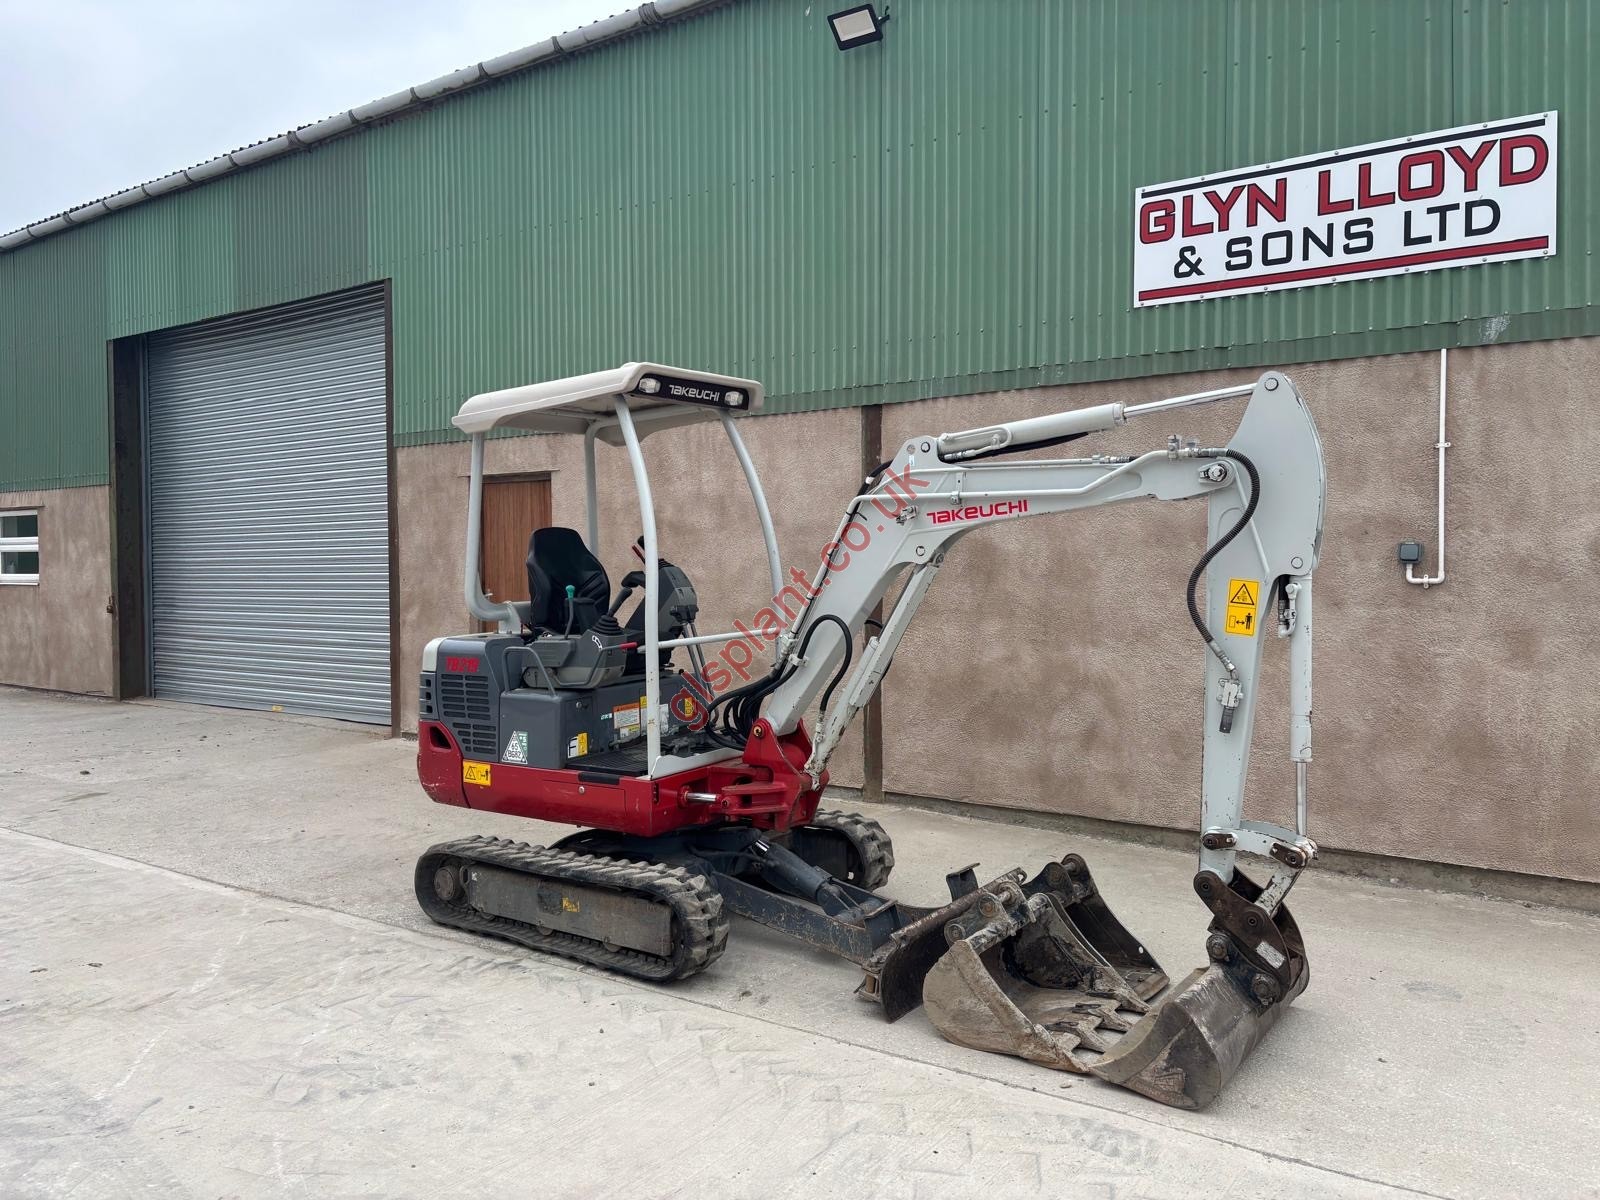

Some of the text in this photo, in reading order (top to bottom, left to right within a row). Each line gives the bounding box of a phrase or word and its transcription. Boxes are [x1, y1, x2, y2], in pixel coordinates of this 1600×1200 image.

[1140, 133, 1549, 244] GLYN LLOYD
[1173, 198, 1501, 279] & SONS LTD
[669, 384, 720, 402] TAKEUCHI
[926, 499, 1029, 524] TAKEUCHI
